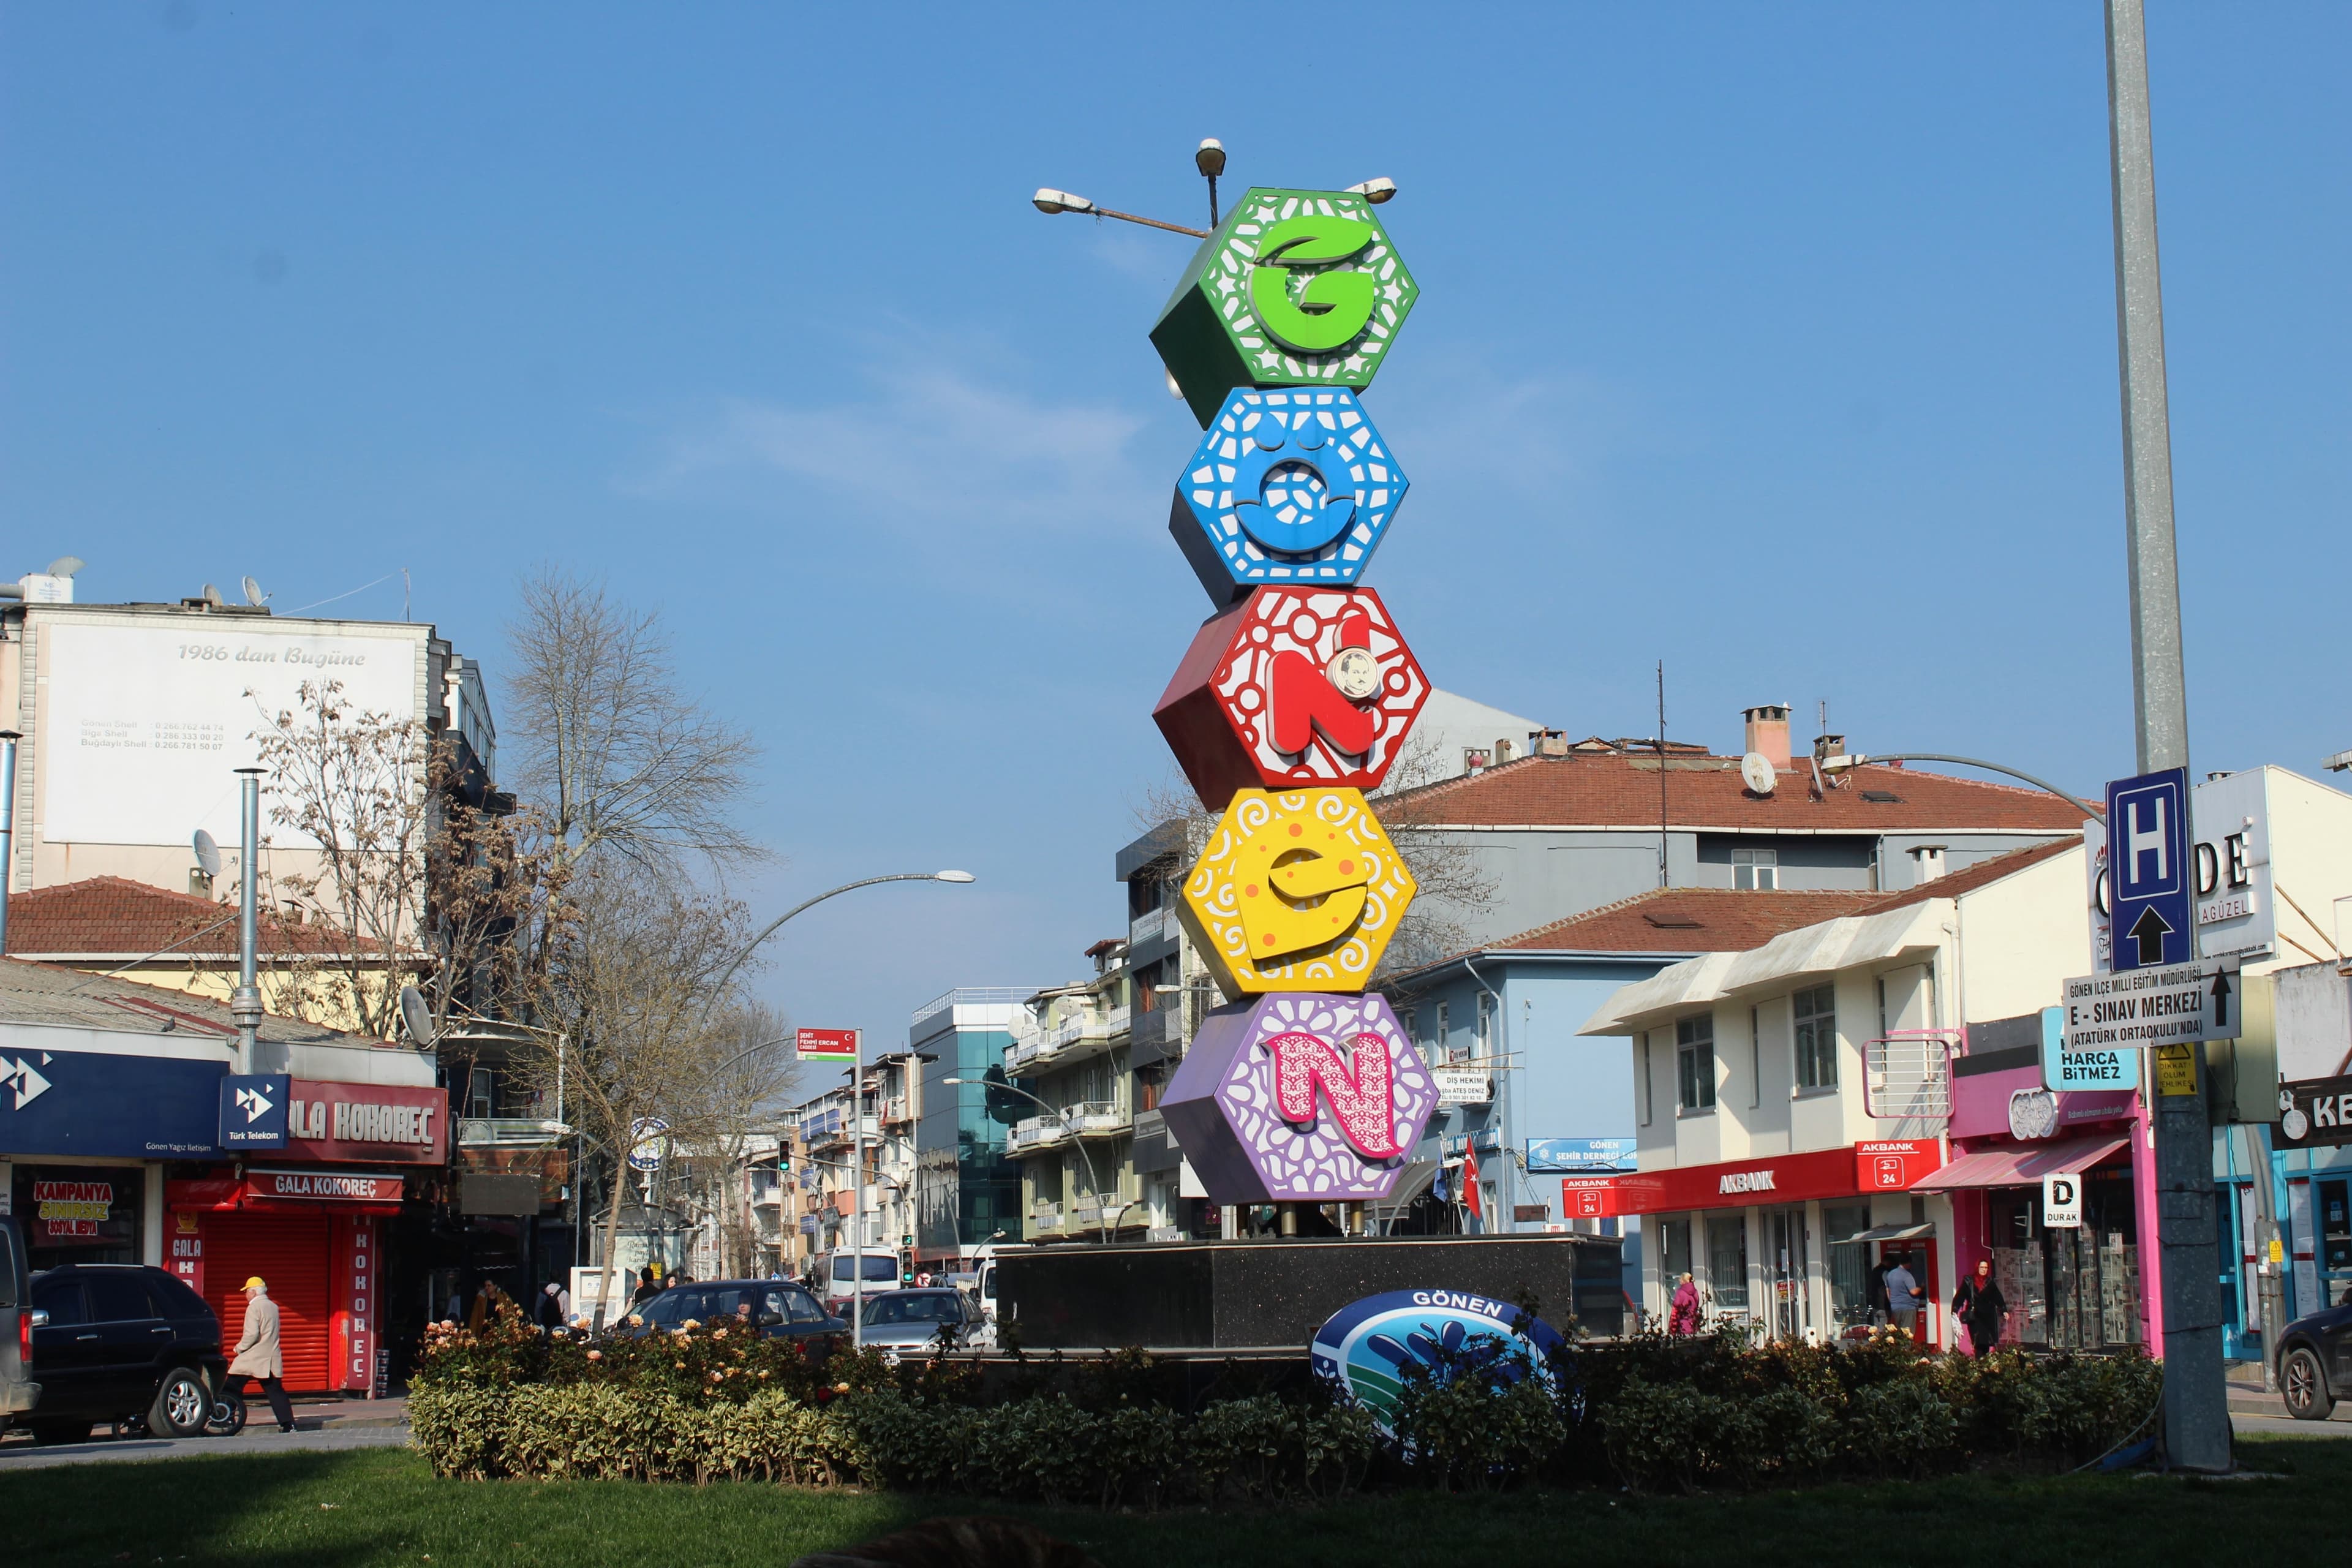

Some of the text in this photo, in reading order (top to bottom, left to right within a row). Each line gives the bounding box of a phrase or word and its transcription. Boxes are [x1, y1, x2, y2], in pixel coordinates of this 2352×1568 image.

[179, 644, 366, 669] 1986 dan Bugüne
[2128, 797, 2168, 884] H
[2070, 965, 2201, 998] GÖNEN İLÇE MİLLİ EĞİTİM MÜDÜRLÜĞÜ
[2070, 1006, 2078, 1026] E
[2094, 998, 2136, 1023] SINAV
[2141, 986, 2203, 1018] MERKEZİ
[2071, 1027, 2117, 1049] (ATATÜRK
[2062, 1052, 2119, 1065] HARCA
[229, 1131, 245, 1140] Türk
[334, 1102, 434, 1152] KOKOREÇ
[146, 1142, 167, 1150] Gönen
[168, 1143, 186, 1152] Yağız
[1589, 1140, 1619, 1149] GÖNEN
[1862, 1143, 1914, 1152] AKBANK
[1556, 1151, 1581, 1162] ŞEHİR
[1583, 1150, 1619, 1160] DERNEĞİ
[276, 1176, 377, 1198] GALA KOKOREÇ
[1719, 1170, 1776, 1194] AKBANK
[1882, 1174, 1896, 1184] 24
[35, 1182, 112, 1202] KAMPANYA
[2053, 1180, 2073, 1205] D
[40, 1202, 108, 1219] SINIRSIZ
[50, 1219, 75, 1235] SOSYAL
[173, 1239, 201, 1257] GALA
[353, 1234, 368, 1378] KOKOREÇ
[1412, 1289, 1502, 1318] GÖNEN
